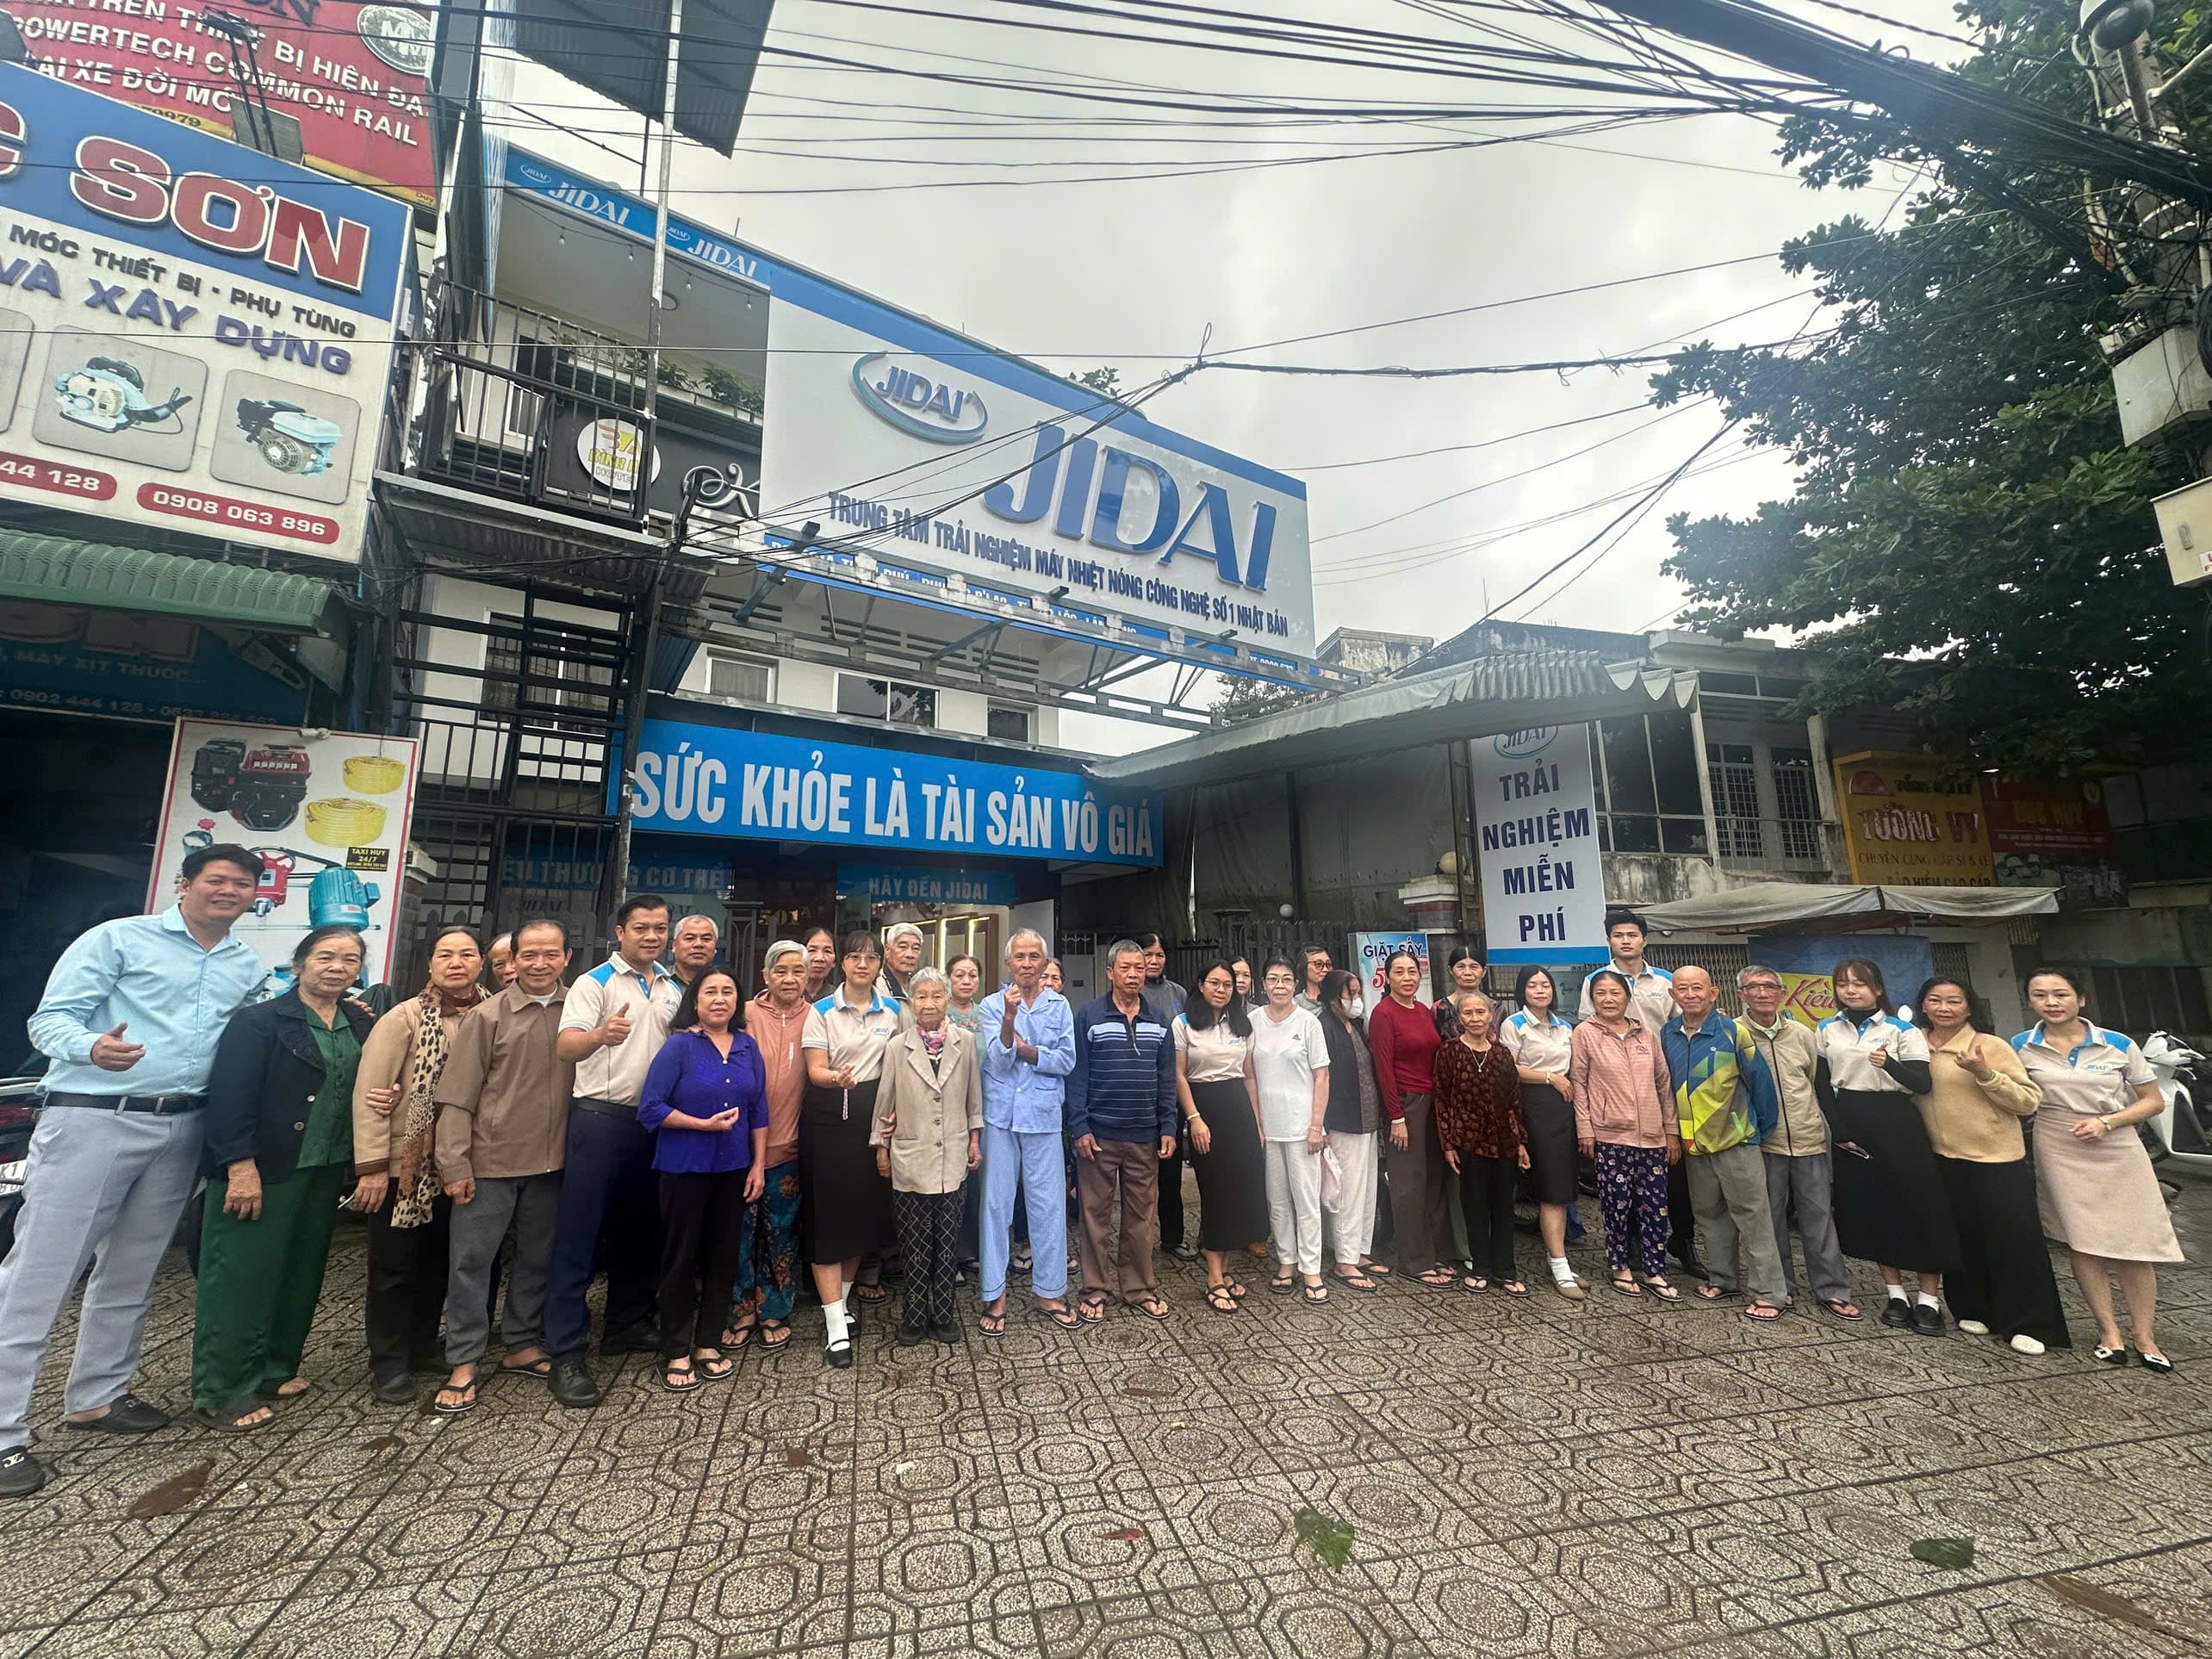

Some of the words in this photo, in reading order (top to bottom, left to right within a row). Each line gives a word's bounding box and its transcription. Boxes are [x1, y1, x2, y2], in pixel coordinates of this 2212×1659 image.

[73, 59, 113, 84] XE
[275, 40, 304, 73] BỊ
[387, 86, 431, 118] ĐẠ
[205, 52, 345, 119] COMMON
[353, 106, 419, 146] RAIL
[69, 135, 371, 295] SƠN
[548, 181, 631, 226] JIDAI
[9, 223, 80, 259] MÓC
[92, 247, 167, 283] THIẾT
[177, 271, 202, 297] BỊ
[230, 287, 282, 319] PHỤ
[292, 306, 357, 338] TÙNG
[687, 239, 757, 278] JIDAI
[84, 276, 198, 332] XÂY
[215, 314, 352, 375] DỰNG
[876, 365, 965, 422] JIDAI
[47, 469, 101, 492] 128
[152, 490, 219, 515] 0908
[227, 505, 274, 526] 063
[281, 516, 326, 537] 896
[982, 420, 1277, 593] JIDAI
[828, 491, 889, 533] TRUNG
[893, 507, 930, 544] TÂM
[934, 519, 971, 555] TRẢI
[974, 531, 1032, 571] NGHIỆM
[1035, 548, 1065, 580] MÁY
[1067, 557, 1105, 593] NHIỆT
[1108, 567, 1144, 601] NÓNG
[1146, 577, 1178, 609] CÔNG
[1180, 589, 1211, 622] NGHỆ
[1212, 594, 1228, 623] SỐ
[1228, 603, 1234, 624] 1
[1237, 604, 1264, 634] NHẬT
[1266, 608, 1289, 637] BẢN
[633, 742, 727, 823] SỨC
[741, 749, 852, 834] KHỎE
[865, 767, 910, 837] LÀ
[922, 774, 975, 843] TÀI
[986, 775, 1052, 849] SẢN
[1061, 791, 1098, 854] VÔ
[1108, 798, 1154, 857] GIÁ
[1499, 758, 1559, 802] TRẢI
[1482, 807, 1591, 852] NGHIỆM
[869, 875, 902, 897] HÃY
[907, 876, 941, 898] ĐẾN
[947, 881, 988, 900] JIDAI
[1502, 853, 1575, 896] MIỄN
[1519, 905, 1566, 942] PHÍ
[1364, 941, 1394, 960] GIẶT
